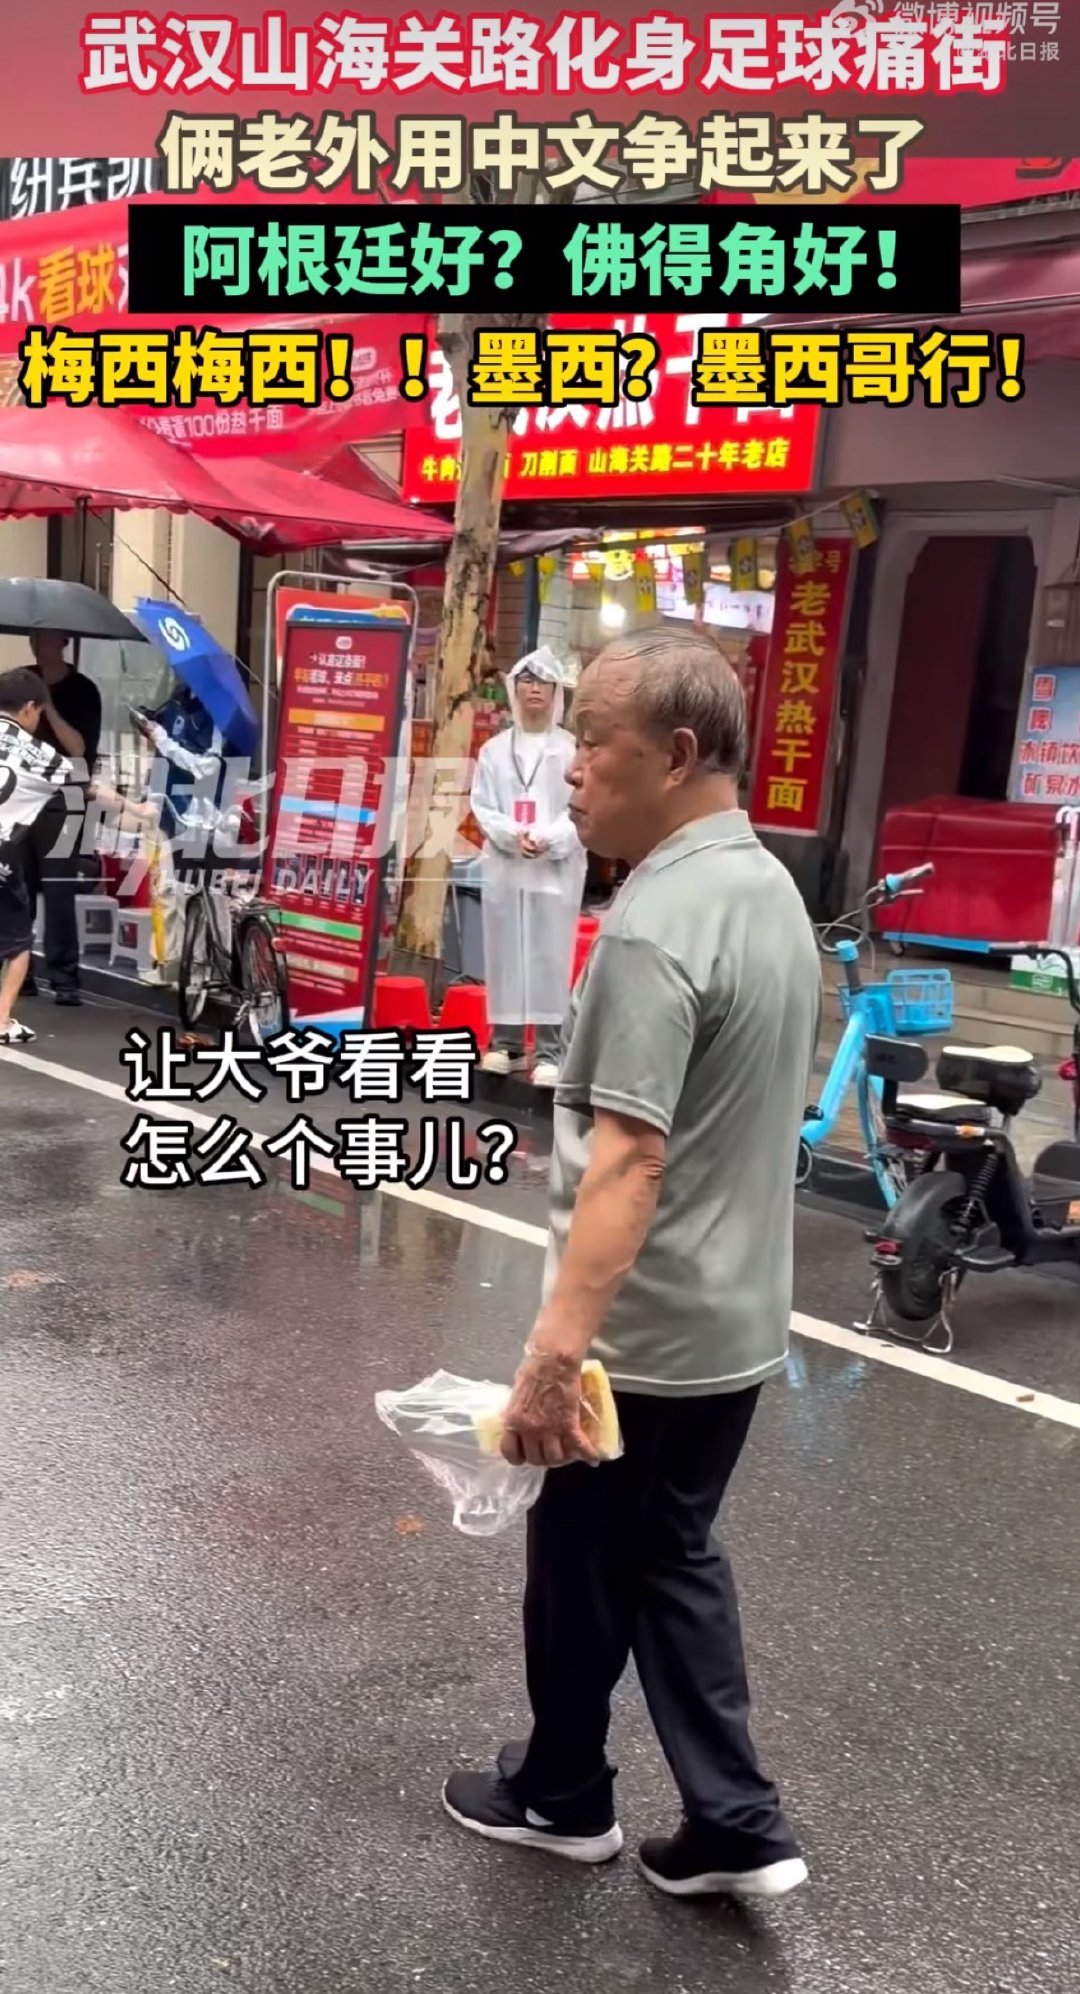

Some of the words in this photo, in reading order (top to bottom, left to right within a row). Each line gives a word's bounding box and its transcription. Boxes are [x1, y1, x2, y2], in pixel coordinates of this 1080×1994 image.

[0, 243, 129, 325] k看球
[140, 404, 285, 439] 100份热干面
[520, 448, 578, 478] 刀削面
[588, 436, 791, 475] 山海关路二十年老店
[766, 581, 831, 812] 老武汉热干面
